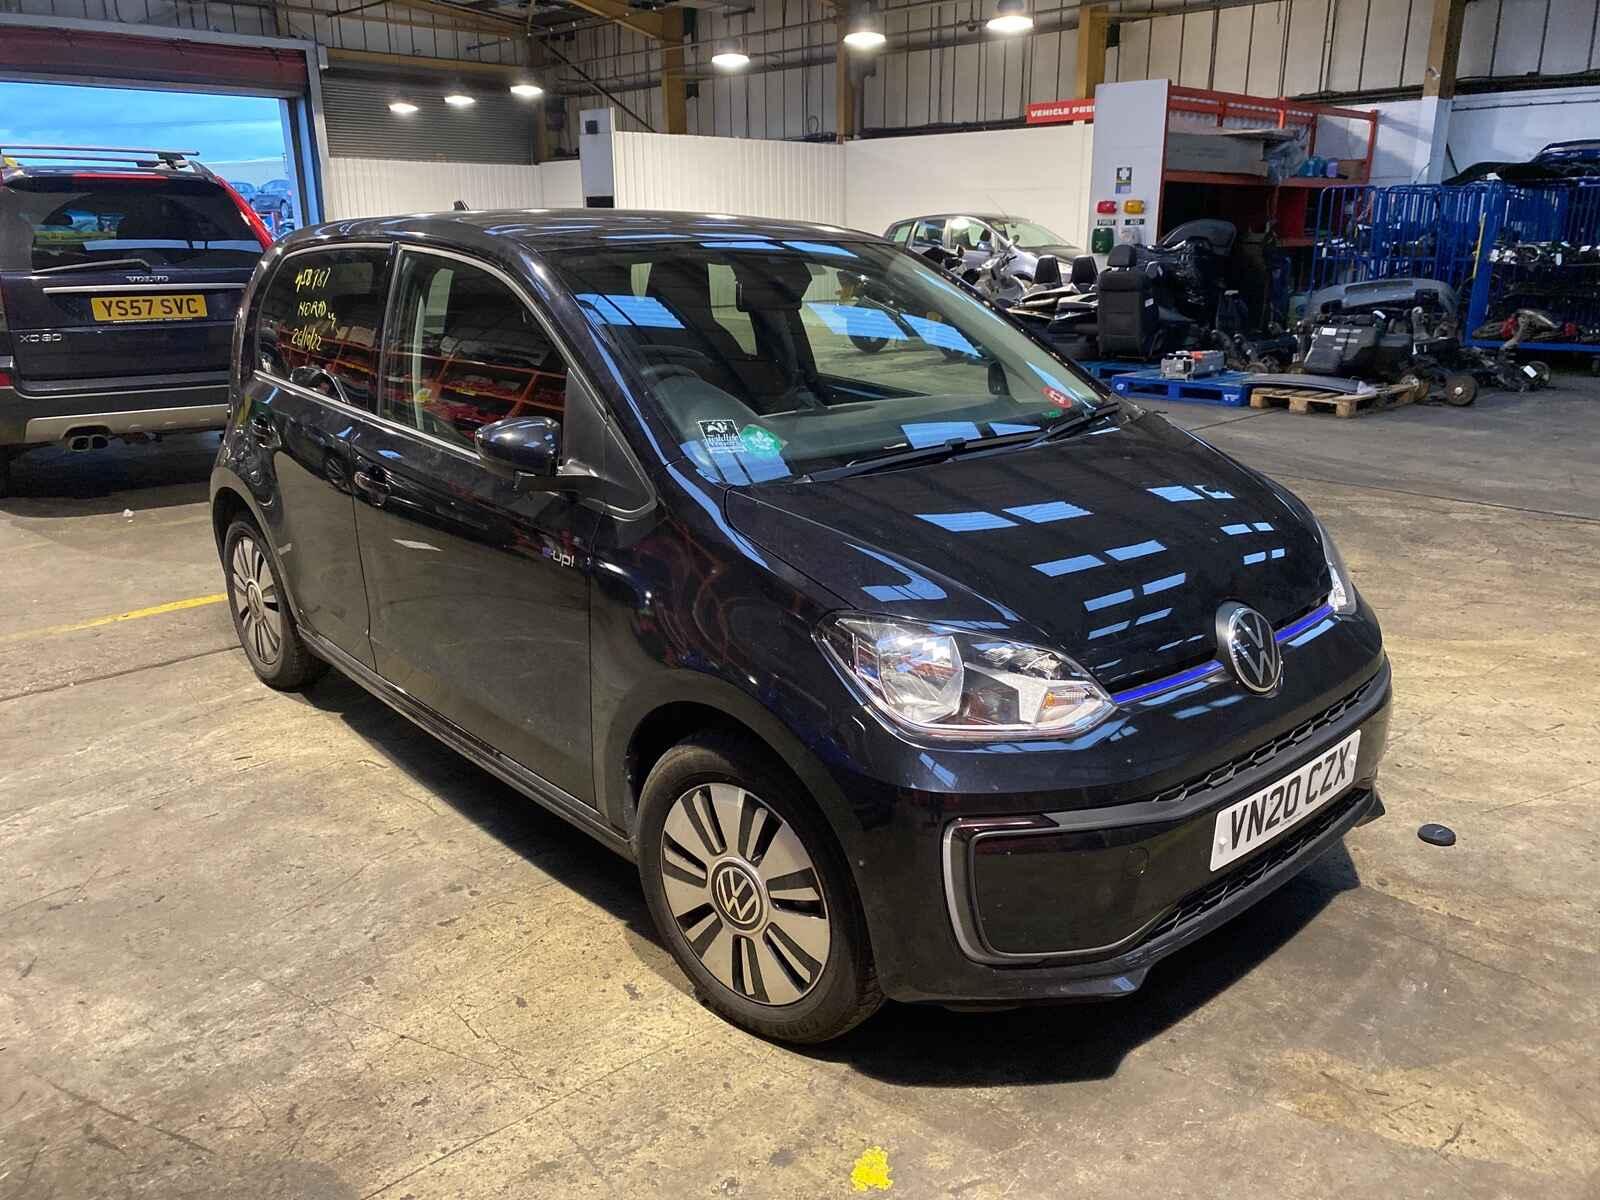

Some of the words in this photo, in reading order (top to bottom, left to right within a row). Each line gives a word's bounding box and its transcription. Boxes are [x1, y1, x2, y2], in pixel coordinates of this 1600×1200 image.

[1030, 107, 1070, 118] VEHICLE
[101, 298, 154, 317] YS57
[161, 298, 198, 315] SVC
[1231, 775, 1302, 850] VN20
[1305, 741, 1351, 805] CZX
